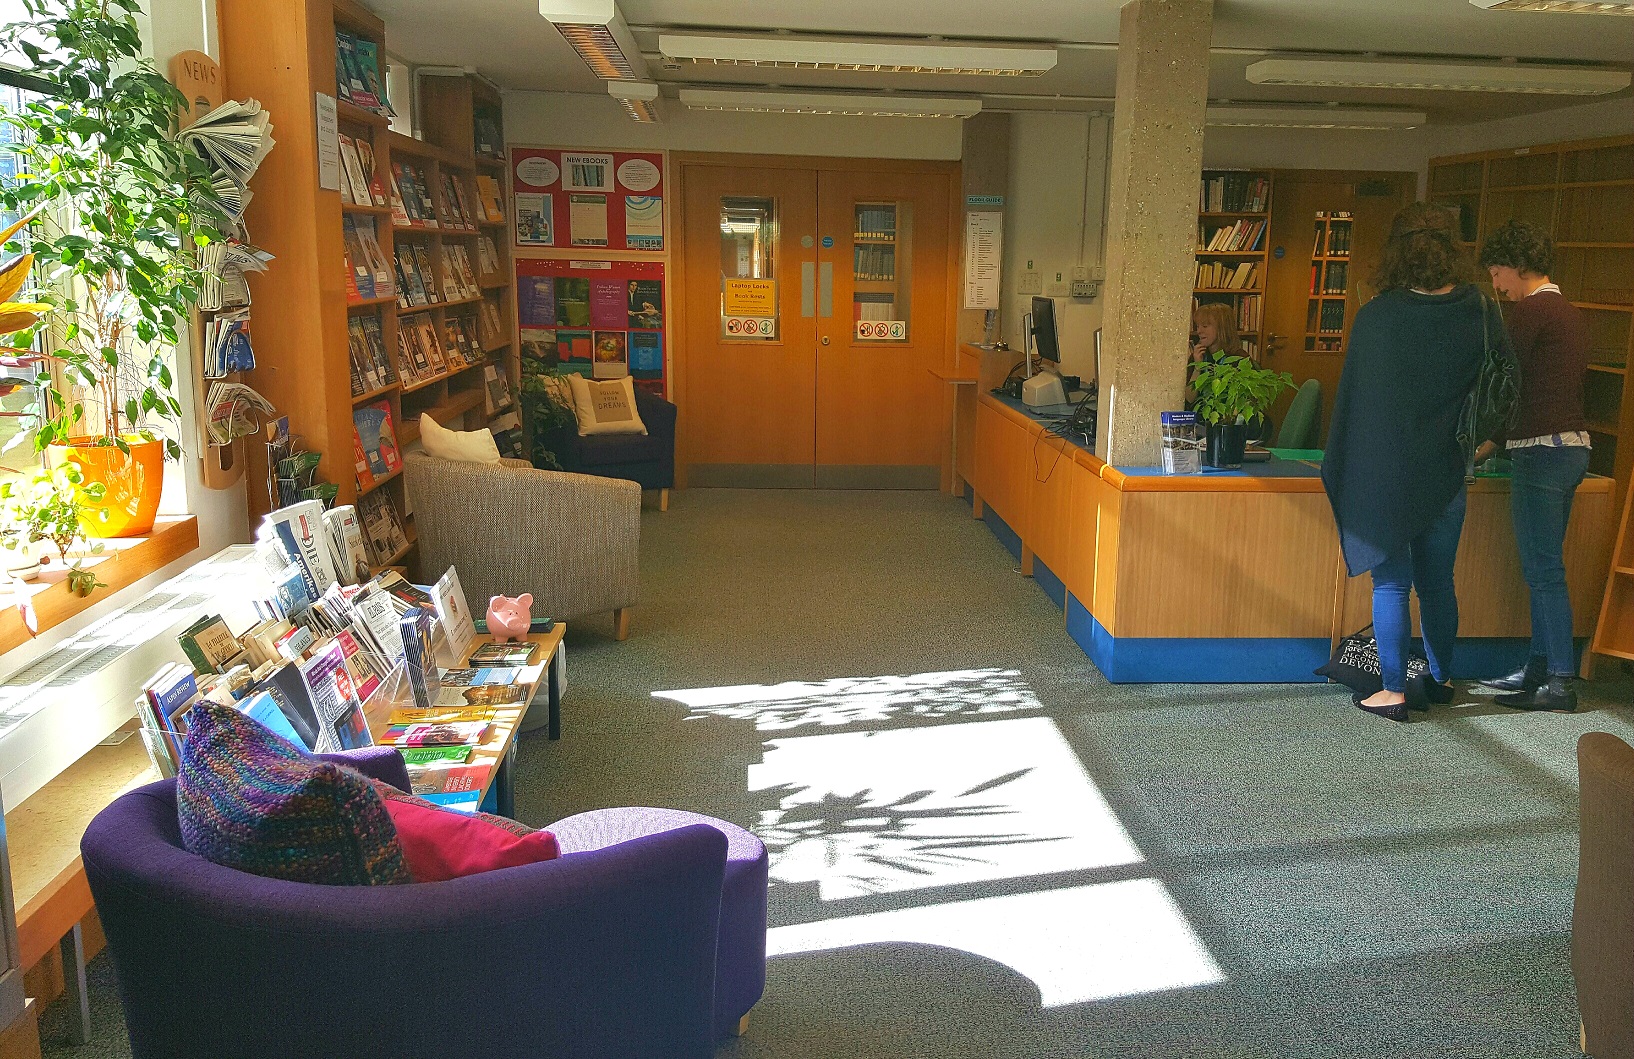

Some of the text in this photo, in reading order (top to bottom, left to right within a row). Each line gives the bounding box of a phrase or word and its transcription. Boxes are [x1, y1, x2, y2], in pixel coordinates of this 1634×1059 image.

[183, 58, 217, 85] NEWS
[582, 157, 609, 165] EBOOKS
[598, 402, 627, 410] DREAMS
[301, 535, 321, 566] DIE
[1339, 656, 1381, 676] DEVON
[1342, 652, 1381, 668] SALCOMB
